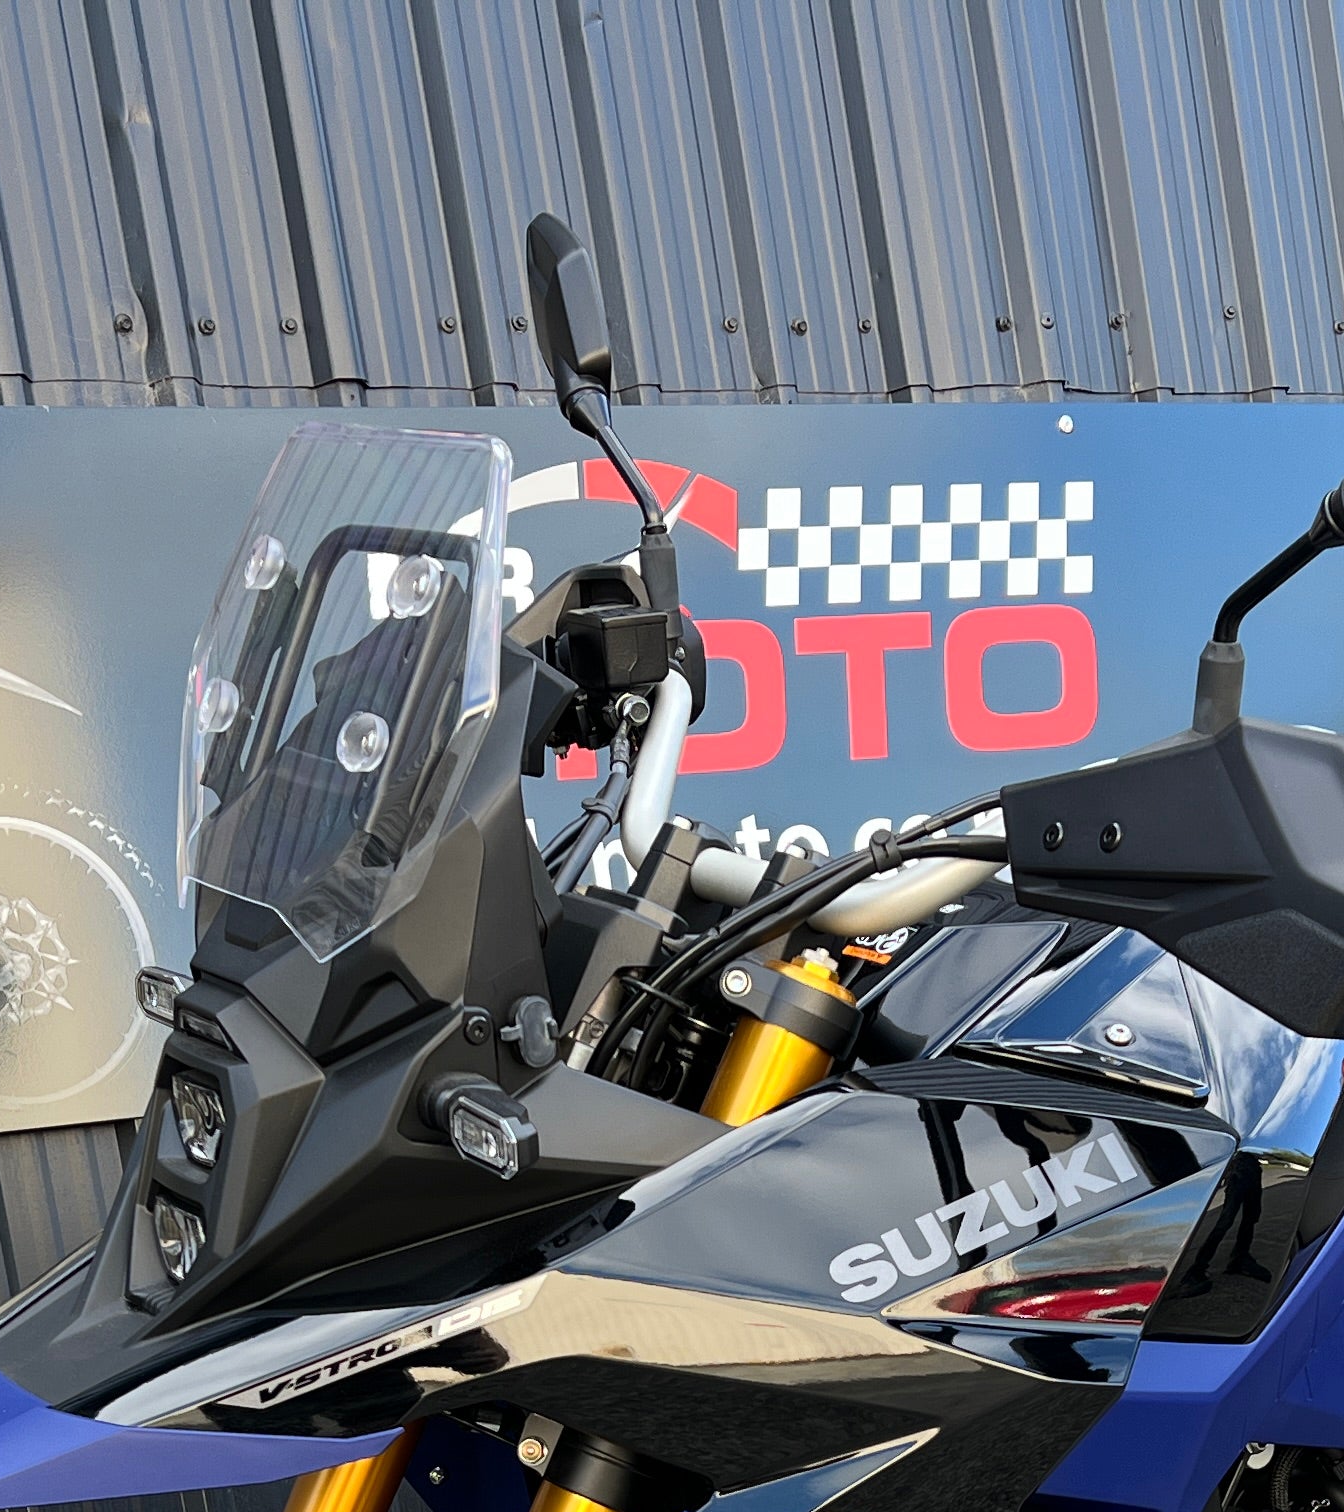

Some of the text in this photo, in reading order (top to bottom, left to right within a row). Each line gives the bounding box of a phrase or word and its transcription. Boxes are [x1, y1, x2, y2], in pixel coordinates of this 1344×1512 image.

[557, 604, 1099, 781] OTO
[829, 1132, 1138, 1303] SUZUKI
[258, 1325, 434, 1404] V-STRO
